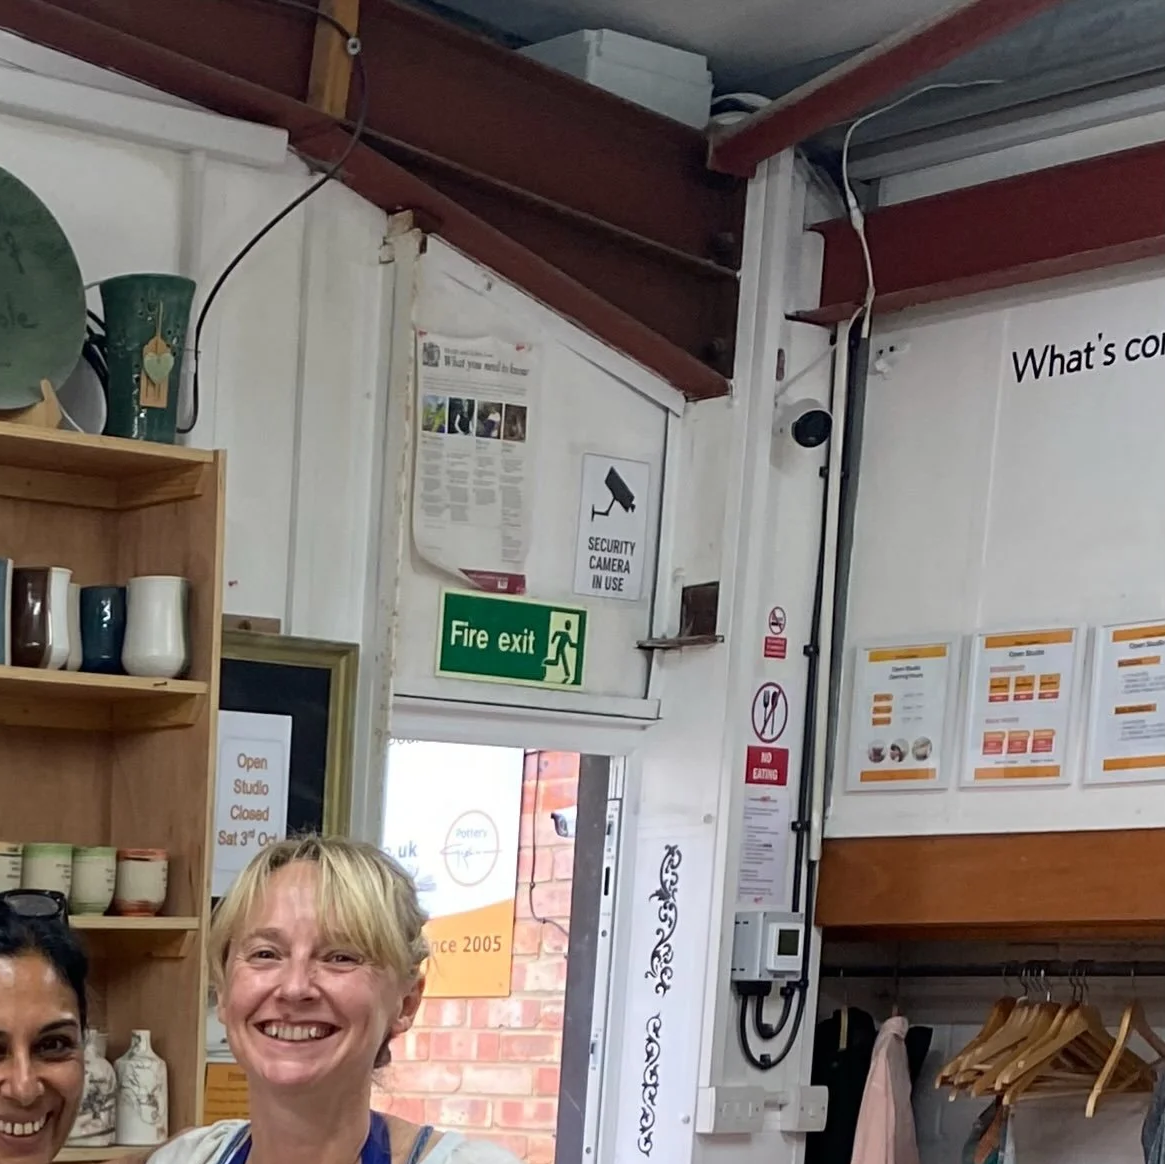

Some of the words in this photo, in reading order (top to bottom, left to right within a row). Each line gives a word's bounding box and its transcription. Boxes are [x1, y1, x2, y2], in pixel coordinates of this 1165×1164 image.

[1011, 332, 1116, 383] What's
[587, 535, 637, 557] SECURITY
[588, 554, 631, 575] CAMERA
[591, 574, 603, 590] IN
[604, 575, 625, 592] USE
[450, 619, 490, 650] Fire
[498, 627, 536, 655] exit
[236, 752, 268, 772] Open
[760, 751, 773, 764] NO
[752, 767, 779, 781] EATING
[233, 778, 270, 796] Studio
[230, 804, 270, 822] Closed
[218, 829, 238, 846] Sat
[462, 935, 503, 954] 2005
